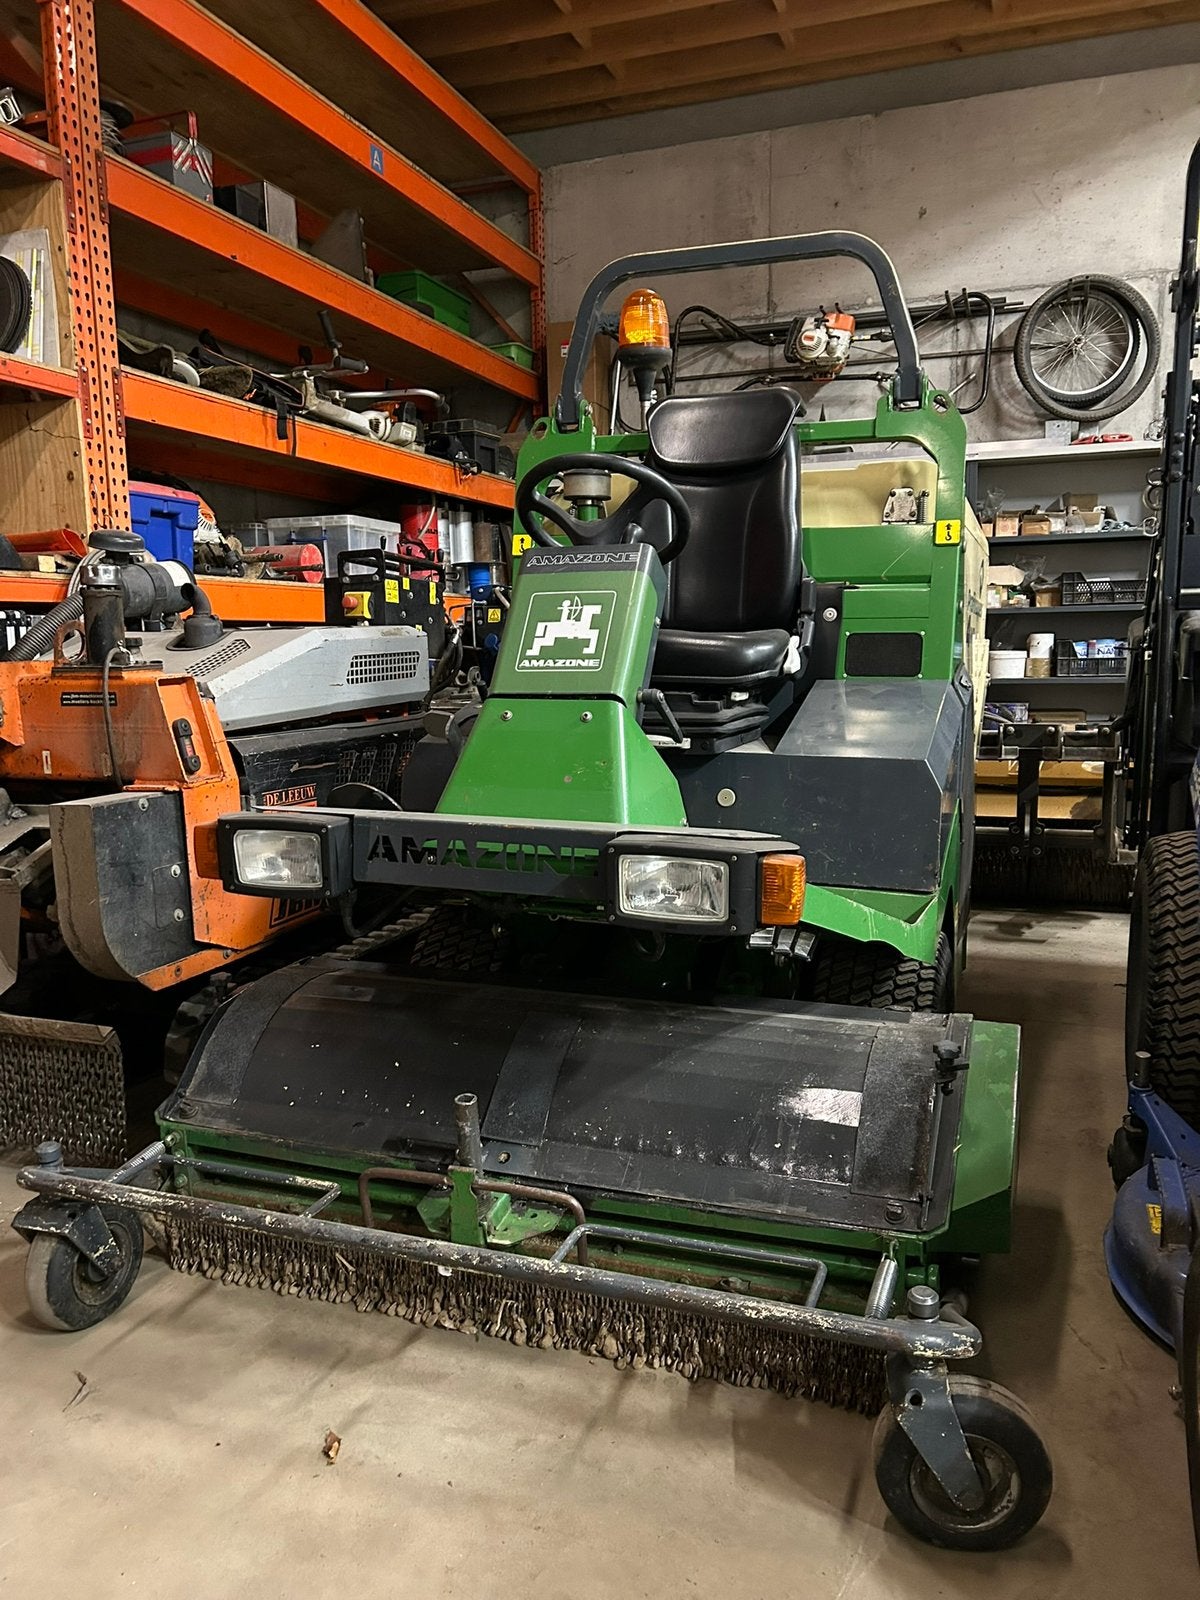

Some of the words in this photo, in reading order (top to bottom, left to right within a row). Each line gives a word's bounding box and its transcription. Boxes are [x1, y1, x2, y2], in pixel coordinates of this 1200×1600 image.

[373, 150, 382, 171] A
[526, 551, 640, 567] AMAZONE
[518, 658, 600, 668] AMAZONE
[266, 793, 281, 806] DE
[282, 786, 316, 803] LEEUW
[366, 834, 600, 877] AMAZONE
